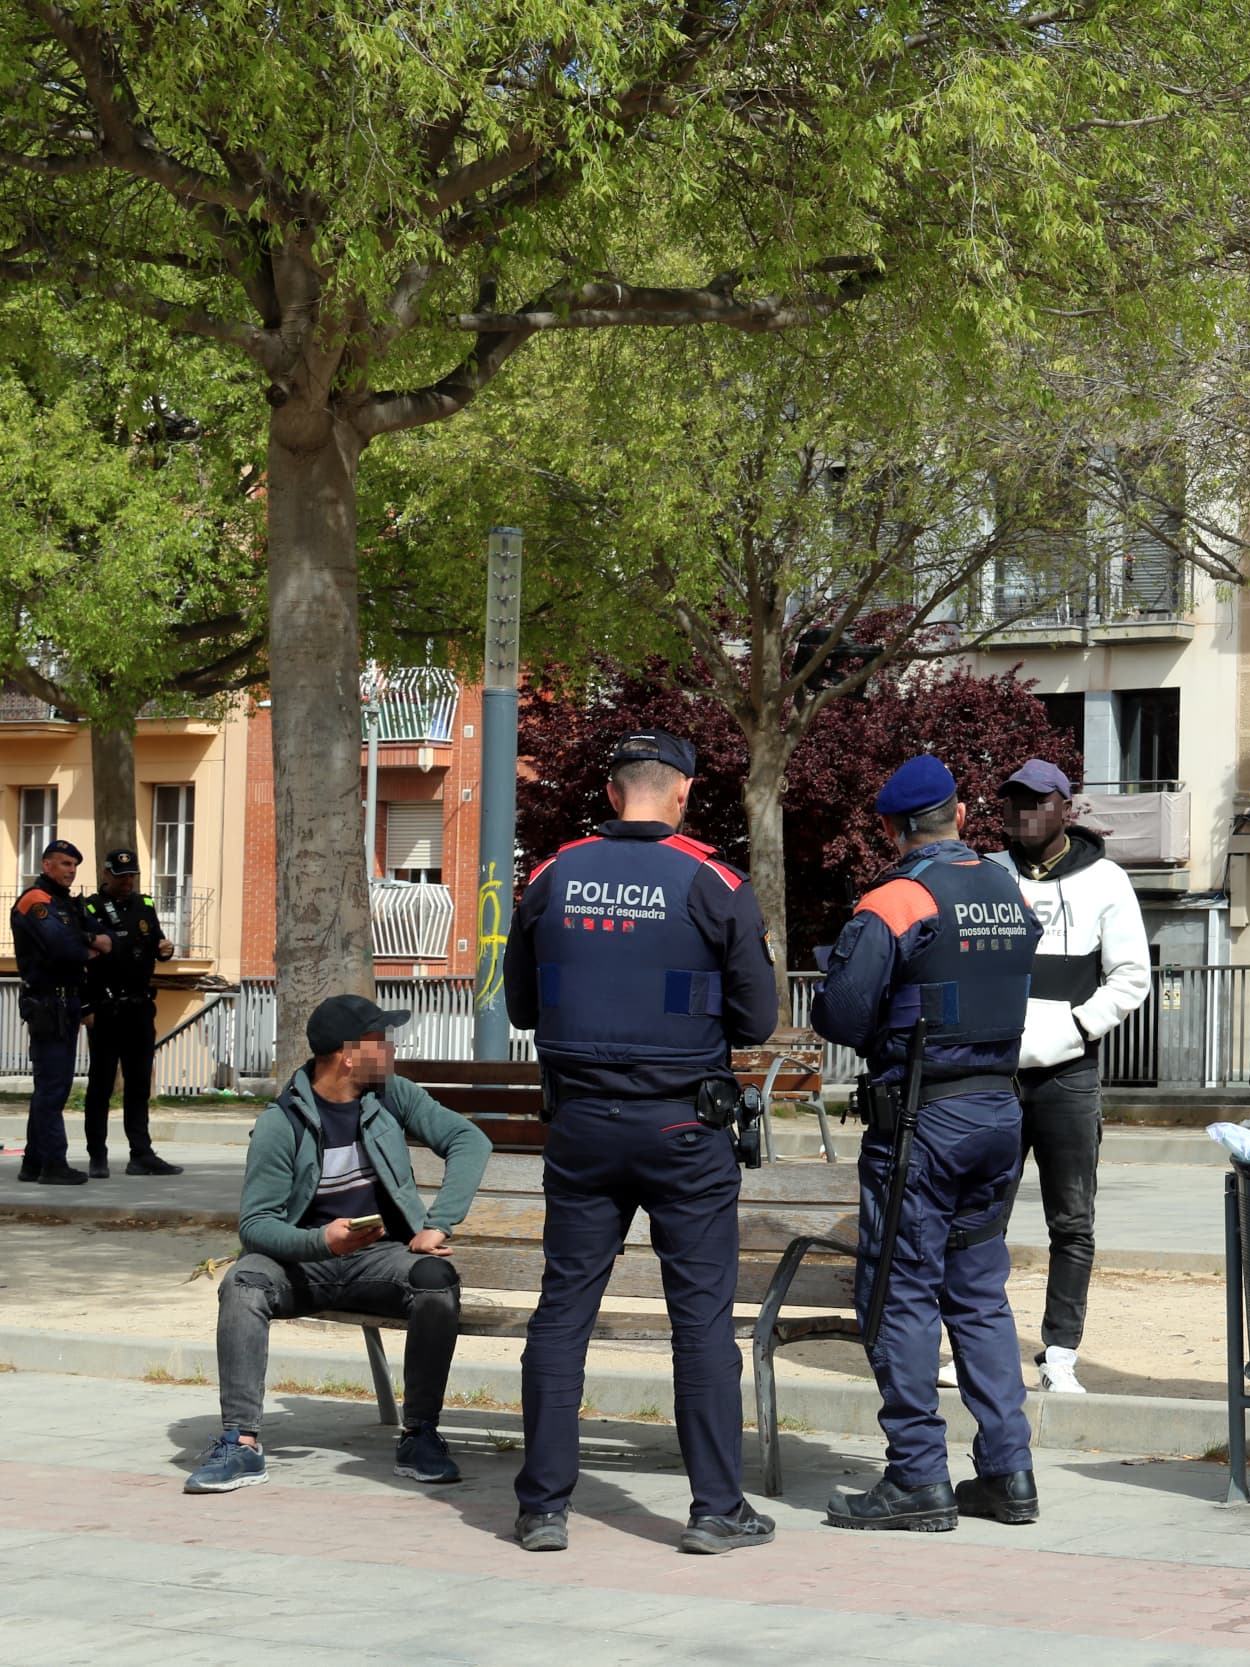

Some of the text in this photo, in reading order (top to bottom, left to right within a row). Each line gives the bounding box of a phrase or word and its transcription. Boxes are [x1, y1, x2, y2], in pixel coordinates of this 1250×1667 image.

[565, 880, 666, 908] POLICIA
[564, 904, 605, 916] mossos
[954, 903, 1025, 925] POLICIA
[959, 926, 990, 937] mossos
